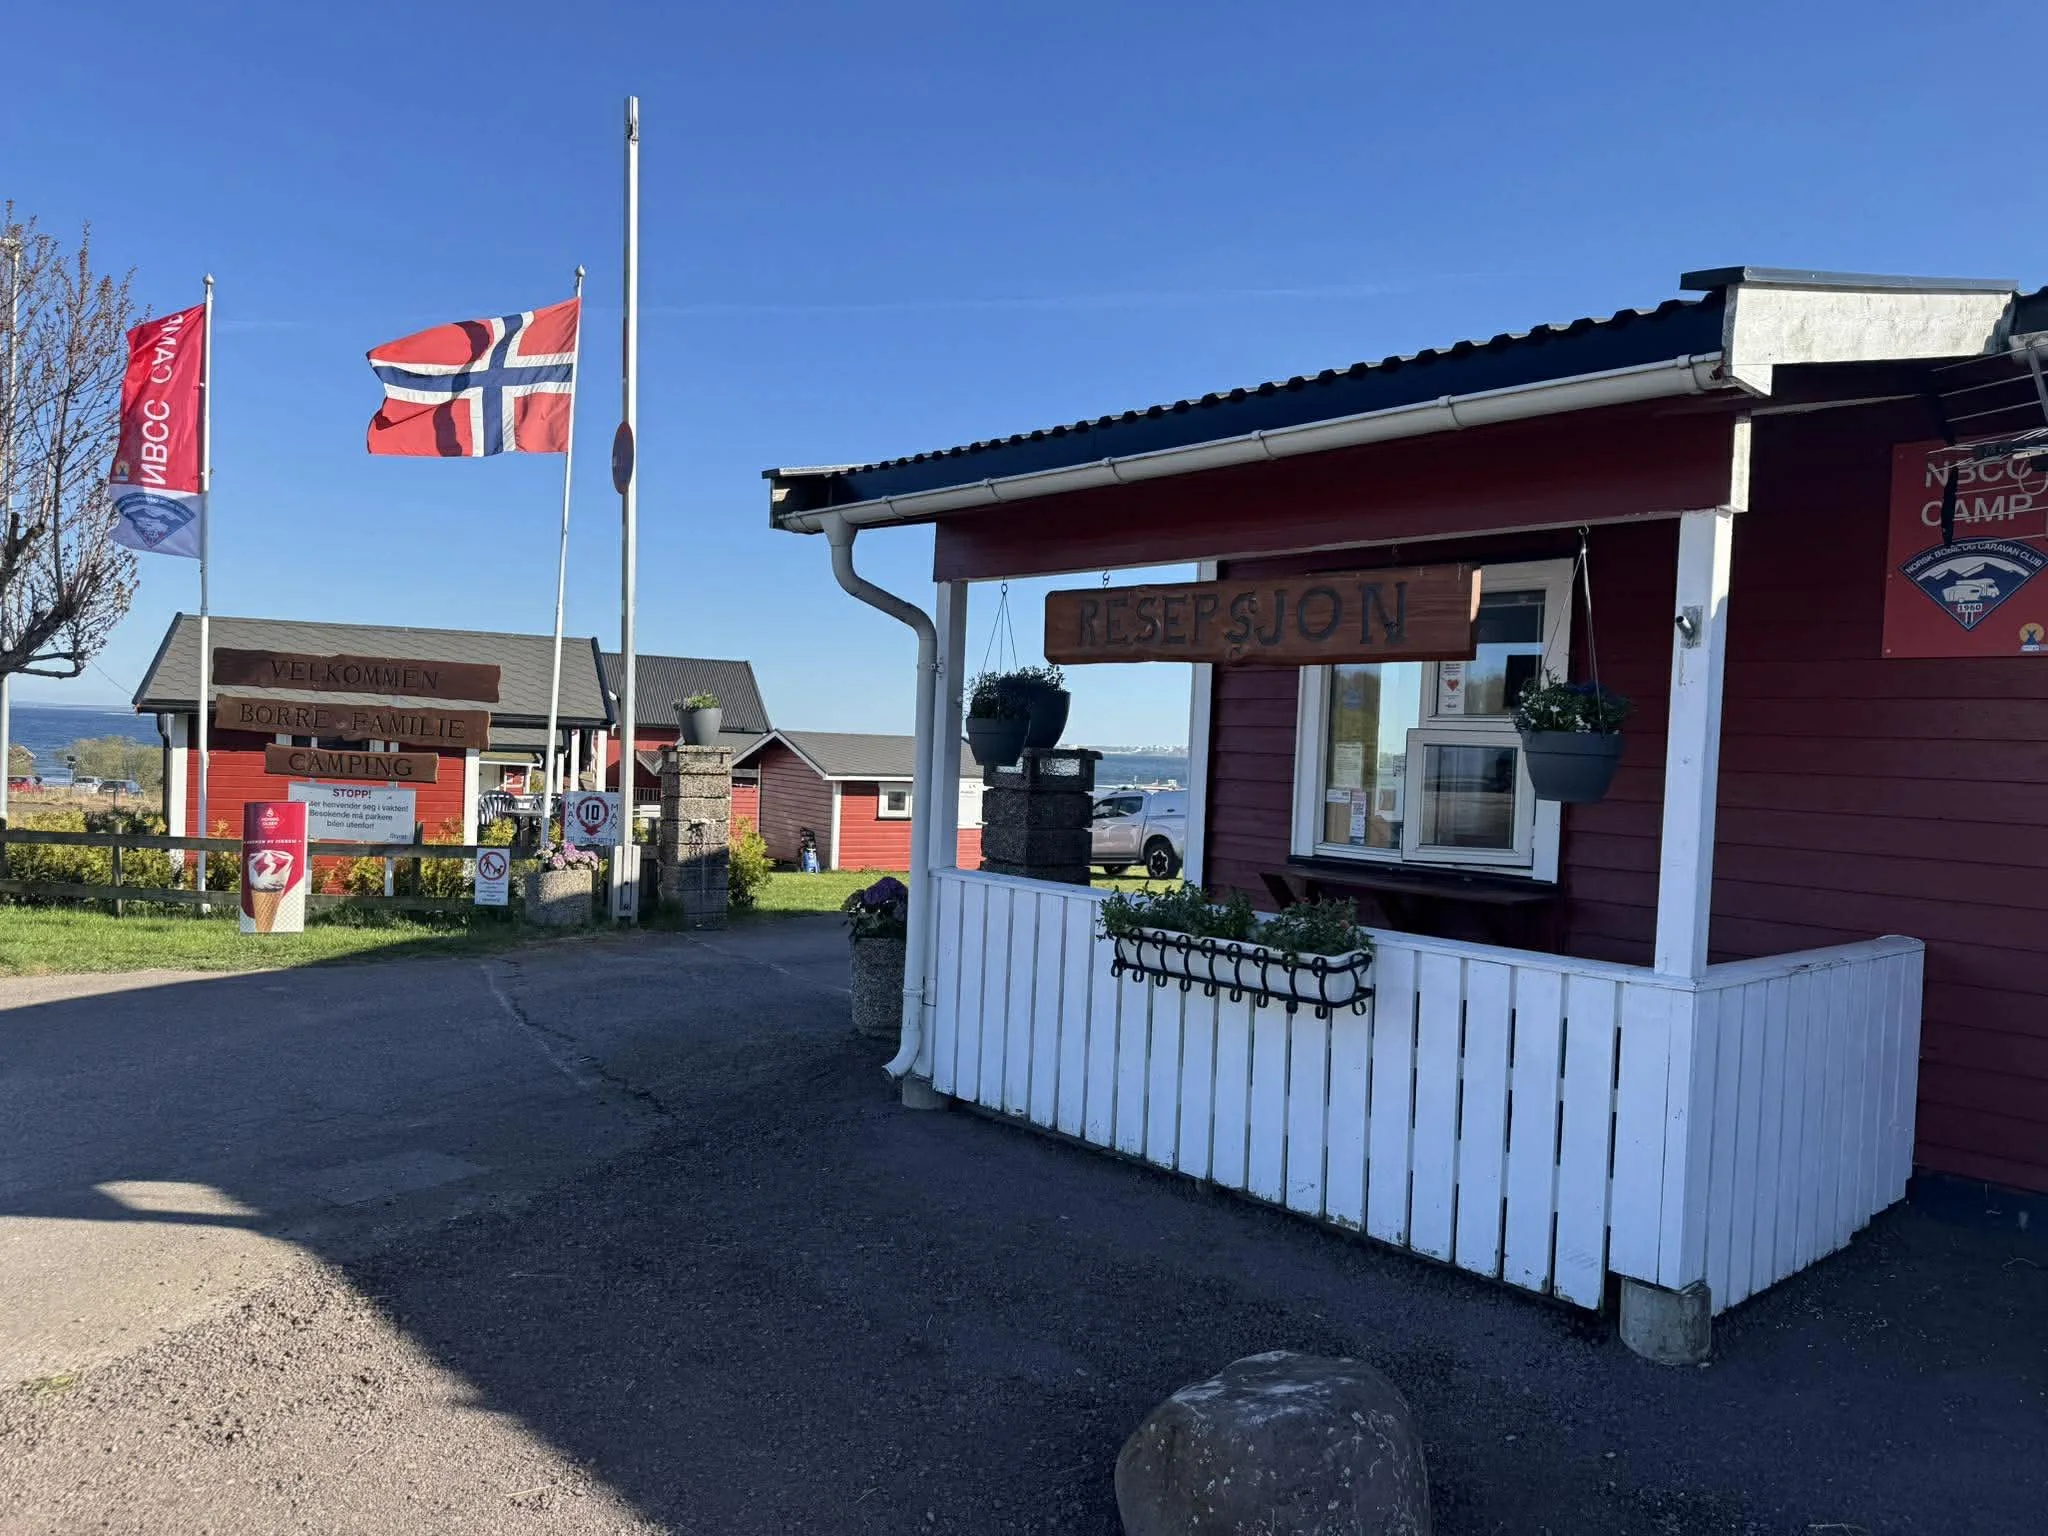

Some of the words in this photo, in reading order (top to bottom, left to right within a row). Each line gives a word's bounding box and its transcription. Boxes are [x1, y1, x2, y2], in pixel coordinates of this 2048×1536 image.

[1921, 494, 2033, 526] CAMP
[1977, 543, 2021, 556] CARAVAN
[2020, 551, 2043, 567] CLUB
[1077, 581, 1408, 647] RESEPSJON
[271, 660, 440, 690] VELKOMMEN
[239, 703, 330, 729] BORRE
[351, 711, 465, 738] FAMILIE
[288, 752, 413, 777] CAMPING
[323, 800, 360, 810] henvender
[332, 788, 372, 799] STOPP!
[365, 813, 393, 823] parkere
[567, 801, 576, 827] MAX
[585, 804, 600, 820] 10
[610, 803, 619, 829] MAX
